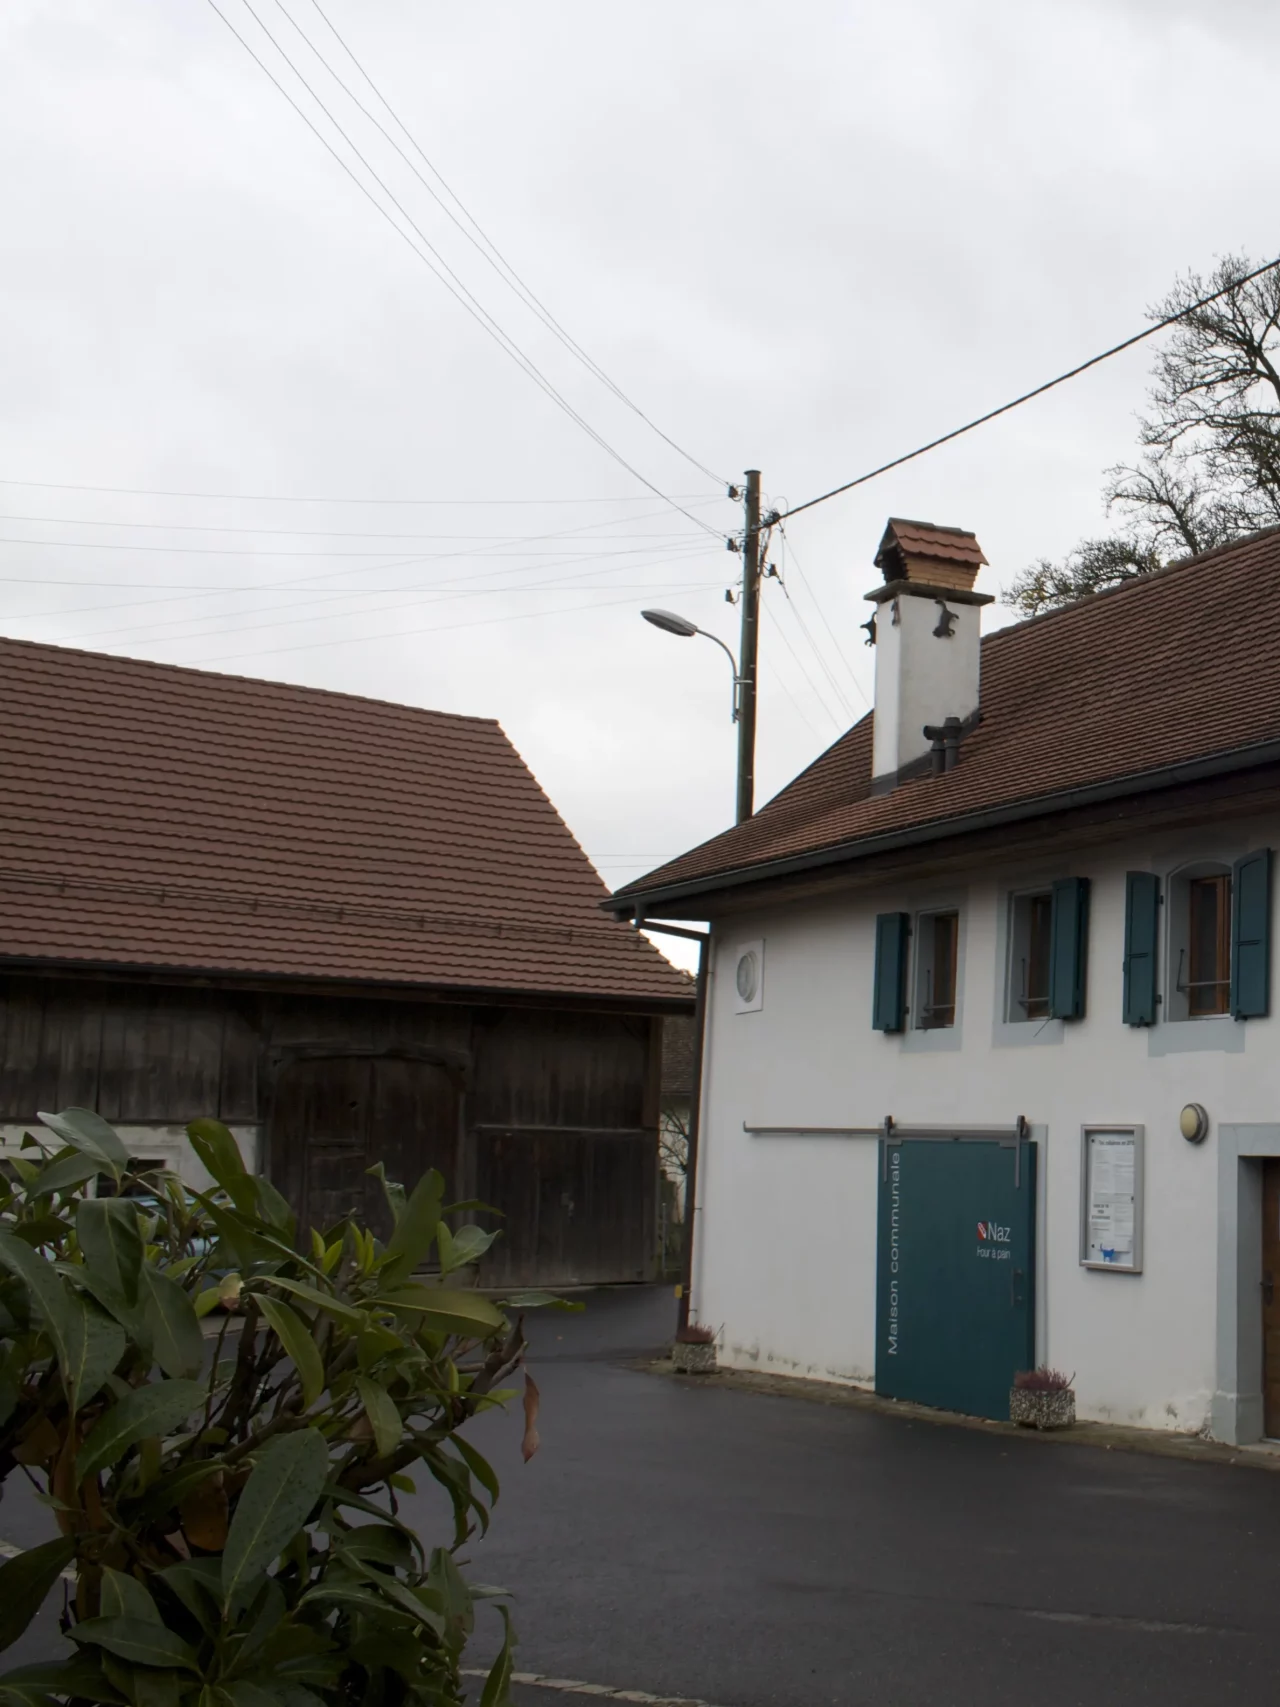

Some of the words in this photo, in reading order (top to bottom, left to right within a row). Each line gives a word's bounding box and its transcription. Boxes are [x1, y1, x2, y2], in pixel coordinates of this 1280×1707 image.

[890, 1152, 900, 1273] communale
[988, 1222, 1011, 1242] Naz
[976, 1246, 990, 1257] Four
[997, 1248, 1010, 1260] pain
[888, 1280, 899, 1355] Maison
